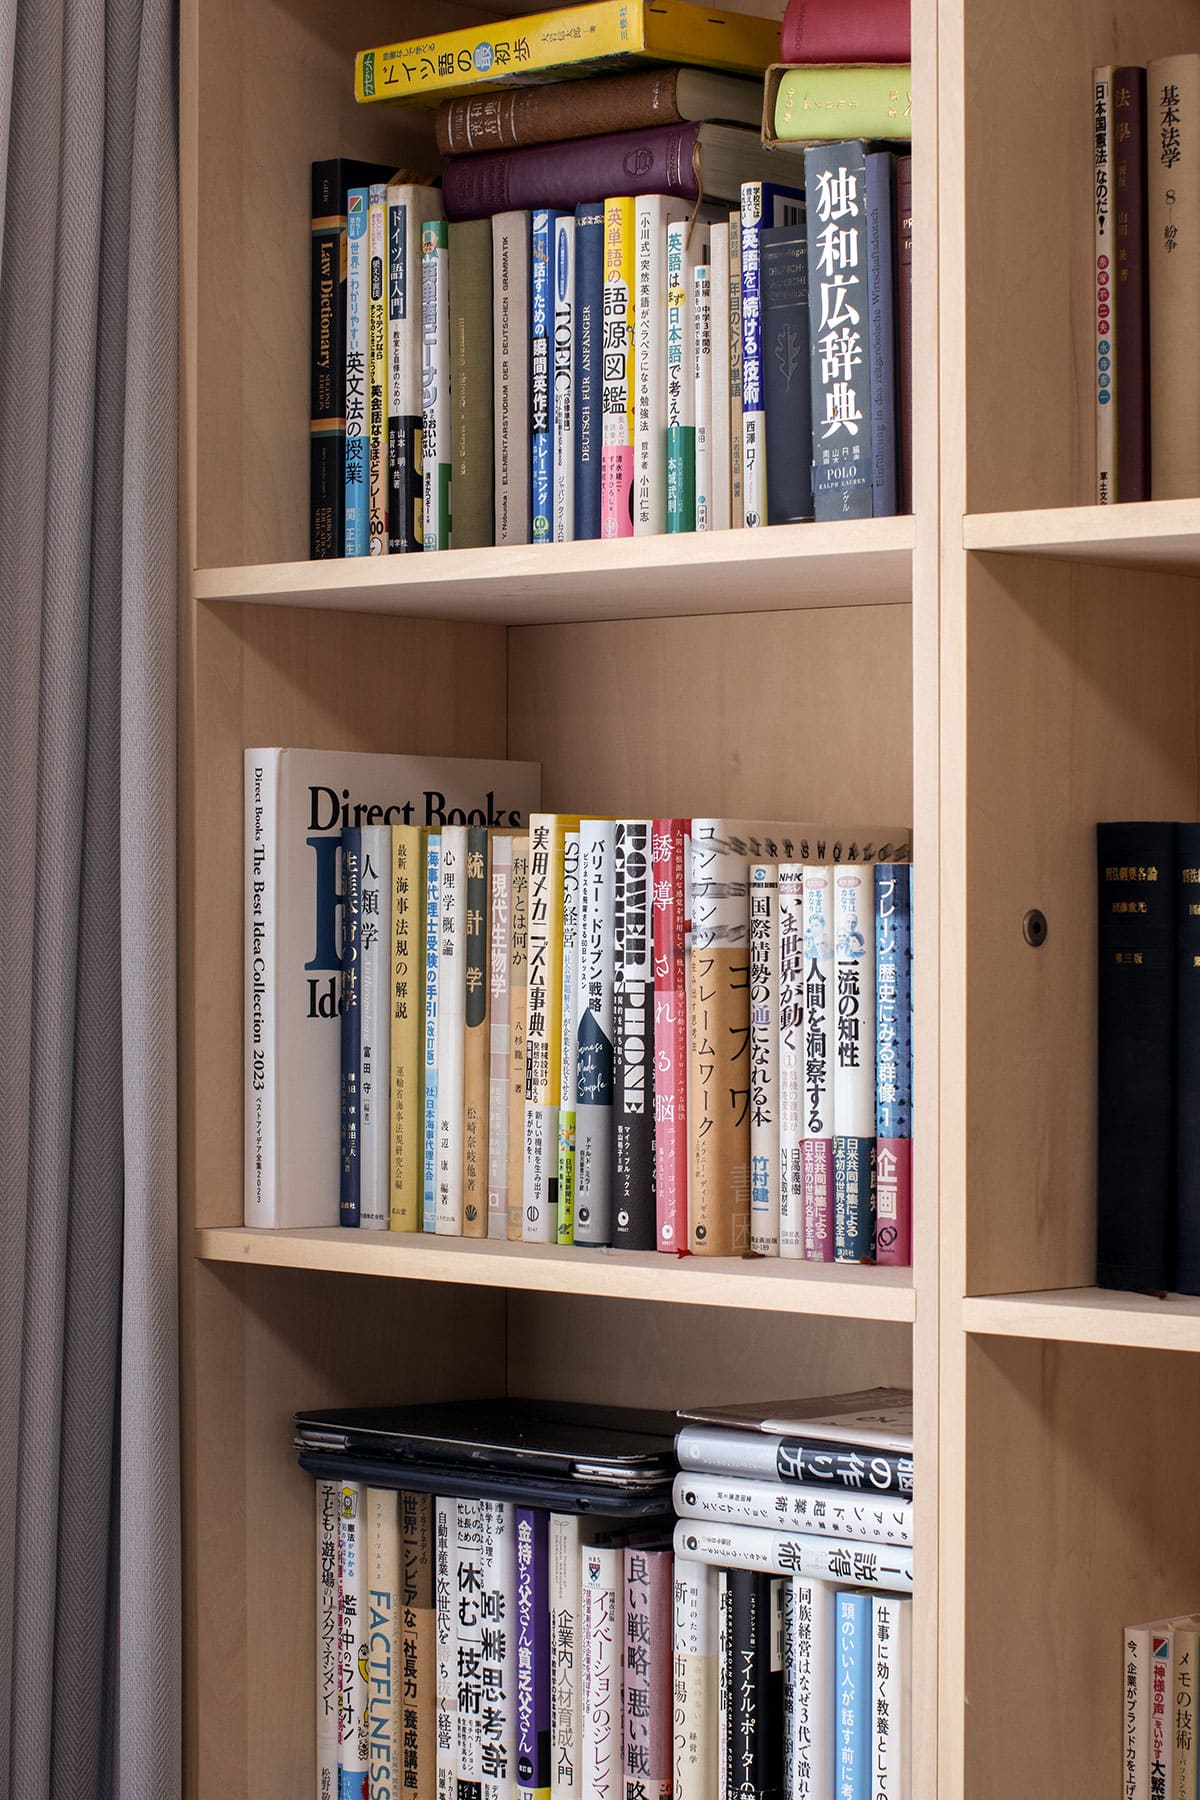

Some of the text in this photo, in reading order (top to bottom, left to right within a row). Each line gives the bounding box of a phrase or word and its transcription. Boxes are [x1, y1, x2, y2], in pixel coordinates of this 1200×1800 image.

[384, 37, 530, 85] ドイツ語の最初歩
[1160, 84, 1181, 253] 基本法学 8 紛争
[317, 242, 334, 368] Law Dictionary
[389, 211, 405, 317] ドイツ語入門
[603, 208, 627, 414] 英単語の語源図鑑
[742, 228, 761, 404] 英語を「続ける」技術
[814, 166, 864, 439] 独和広辞典
[870, 208, 882, 306] Wirtschaftsdeutsch
[344, 242, 364, 485] 世界一わかりやすい英文法の授業
[376, 304, 384, 360] ネイティブなら
[533, 262, 548, 505] 話すための瞬間英作文トレーニング
[555, 302, 571, 391] TOEIC
[582, 305, 591, 462] DEUTSCH FÜR ANFÄNGER
[730, 273, 741, 397] 一年目のドイツ単語
[640, 475, 649, 522] 小川仁志
[818, 477, 866, 490] RALPH LAUREN
[826, 464, 857, 481] POLO
[254, 767, 263, 804] Direct
[254, 805, 263, 841] Books
[307, 786, 521, 831] Direct Books
[253, 844, 265, 878] The
[253, 881, 265, 916] Best
[361, 853, 379, 951] 人類学
[443, 851, 456, 957] 心理学概論
[466, 852, 484, 993] 統計学
[513, 857, 528, 966] 科学とは何か
[563, 841, 579, 948] SDGs経営
[779, 873, 803, 882] NHK
[253, 921, 265, 957] Idea
[395, 876, 409, 1019] 海事法規の解説
[491, 873, 508, 999] 現代生物学
[529, 826, 549, 1037] 実用メカニズム事典
[588, 840, 605, 1012] バリュー・ドリブン戦略
[624, 824, 647, 1114] POWER PHONE
[653, 834, 675, 1123] 誘導される脳
[699, 826, 717, 1137] コンテンツフレームワーク
[780, 898, 803, 1051] いま世界が動く
[253, 958, 265, 1044] Collection
[750, 896, 772, 1127] 国際情勢の通になれる本
[806, 957, 827, 1133] 人間を洞察する
[838, 959, 860, 1067] 一流の知性
[253, 1049, 265, 1091] 2023
[534, 1110, 544, 1200] 新しい機械を生み出す
[752, 1155, 769, 1212] 竹村健一
[877, 1148, 898, 1221] 企画
[347, 1523, 355, 1578] 憲法がわかる
[457, 1518, 481, 1529] 社長の
[457, 1532, 481, 1543] ための
[321, 1485, 336, 1716] 子どもの遊び場のリスクマネジメント
[403, 1494, 418, 1789] 世界一シビアな「社長力」養成講座
[457, 1546, 481, 1714] 「休む」技術
[518, 1520, 533, 1753] 金持ち父さん貧乏父さん
[690, 1588, 698, 1652] 明日のための
[369, 1590, 391, 1800] FACTFULNESS
[557, 1609, 574, 1786] 企業内人材育成入門
[592, 1591, 613, 1799] イノベーションのジレンマ
[626, 1555, 652, 1800] 良い戦略、悪い戦略
[674, 1580, 688, 1800] 新しい市場のつくり
[798, 1587, 812, 1800] 同族経営はなぜ3代で潰れ
[1125, 1640, 1138, 1800] 今、企業がブランド力を上げ
[1176, 1652, 1192, 1751] メモの技術
